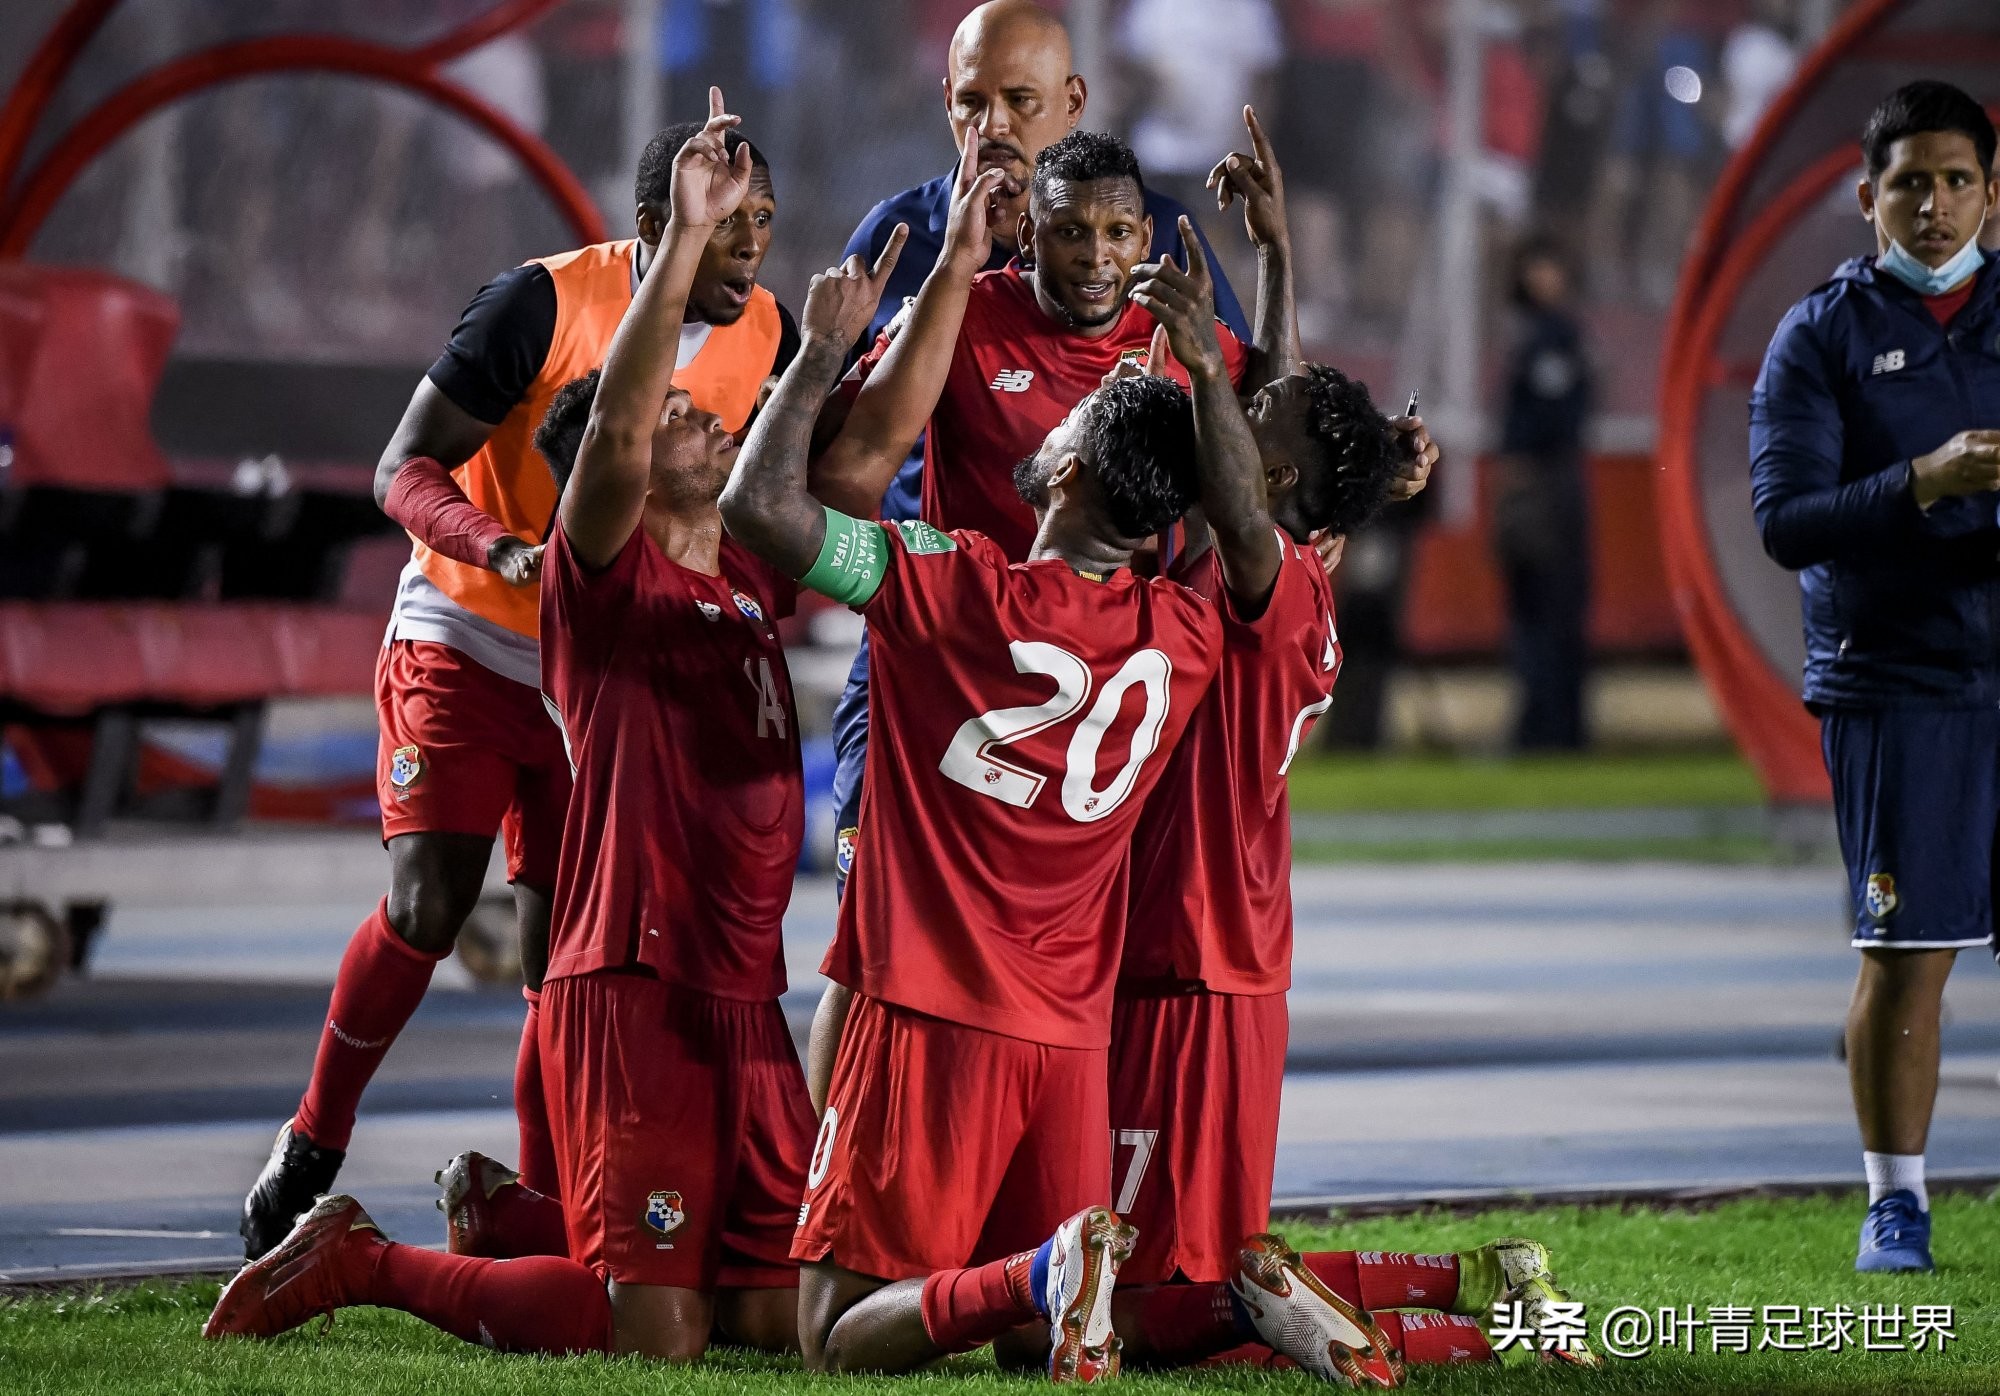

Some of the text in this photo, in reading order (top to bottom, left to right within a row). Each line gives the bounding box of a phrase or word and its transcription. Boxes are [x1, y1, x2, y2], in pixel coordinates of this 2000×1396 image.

[989, 369, 1035, 393] NB
[831, 532, 850, 567] FIFA
[938, 639, 1173, 823] 20
[1109, 1128, 1160, 1214] 7
